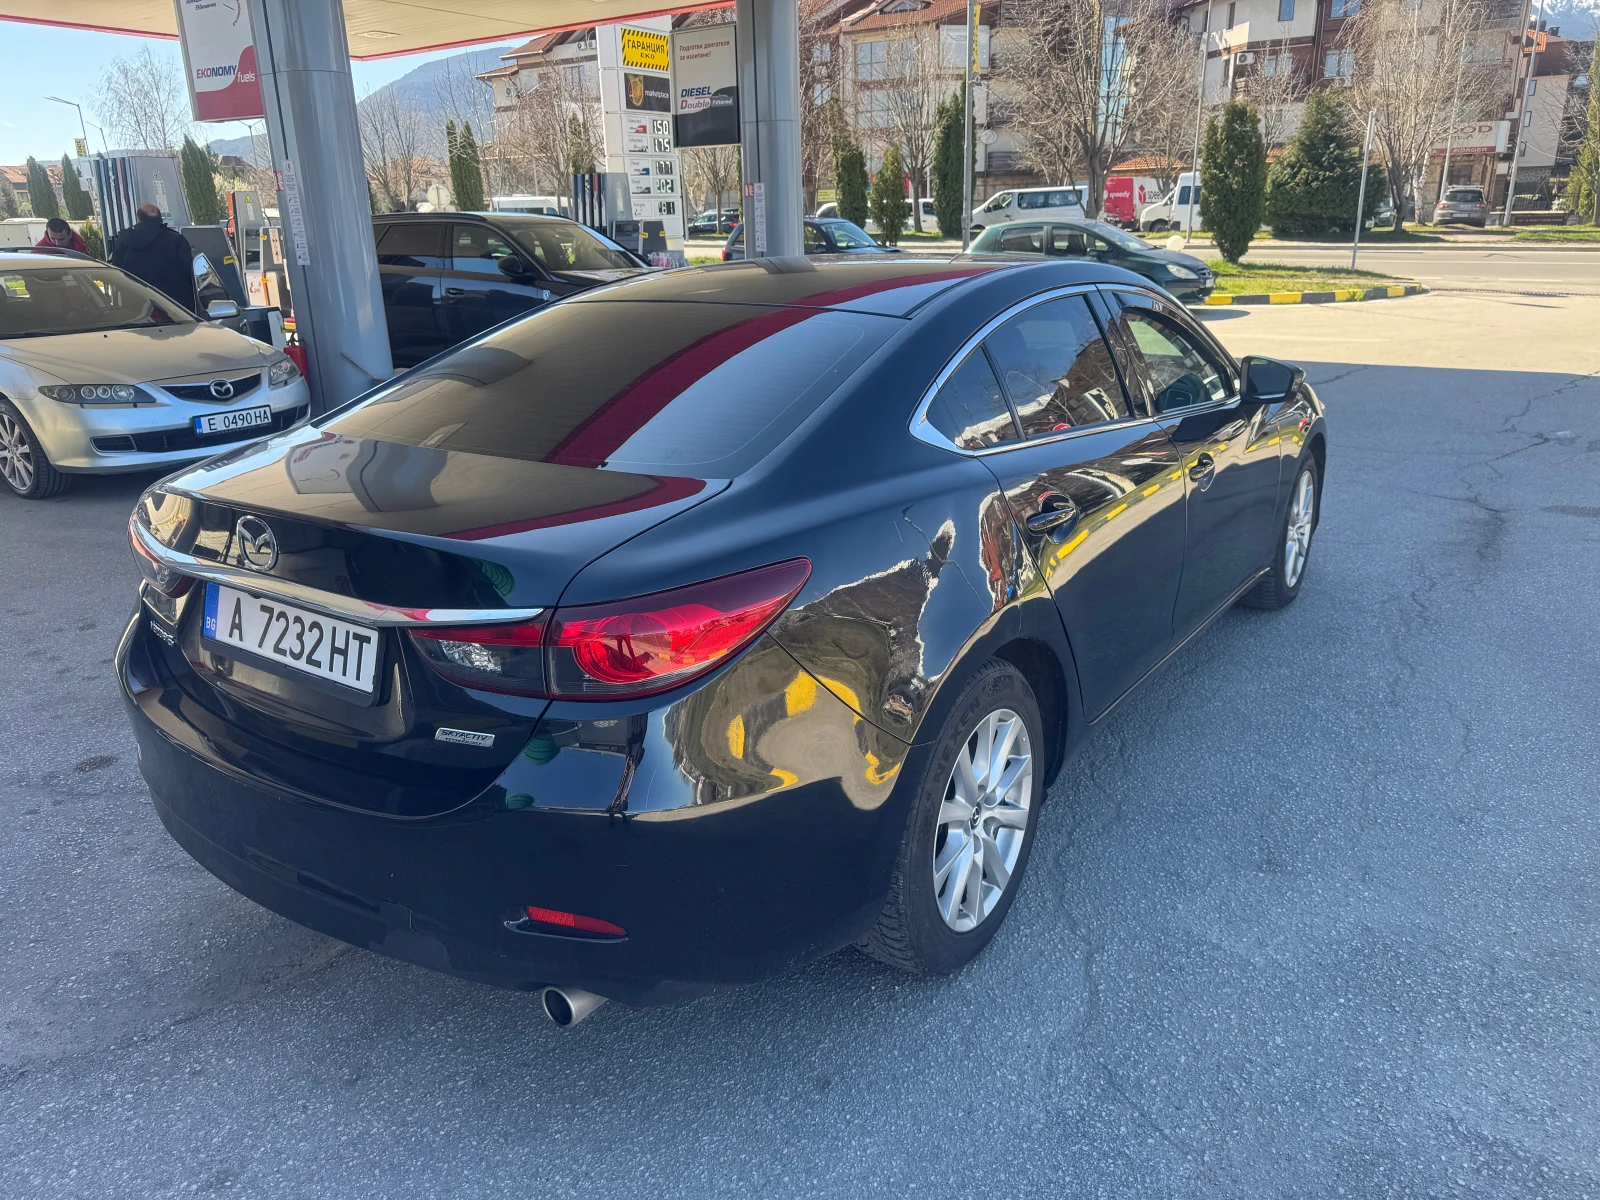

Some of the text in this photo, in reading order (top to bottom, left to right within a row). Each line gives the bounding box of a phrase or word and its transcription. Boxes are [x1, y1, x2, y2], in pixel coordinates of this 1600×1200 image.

[627, 39, 665, 54] ГАРАНЦИЯ
[679, 40, 730, 52] Подготви двигателя
[196, 65, 237, 79] EKONOMY
[237, 71, 255, 82] fuels
[644, 90, 670, 99] marketplace
[681, 86, 712, 98] DIESEL
[680, 98, 733, 110] Double Filtered
[1109, 190, 1130, 200] speedy
[207, 417, 217, 431] E
[205, 616, 216, 630] BG
[228, 597, 243, 642] A
[440, 730, 489, 740] SKYACTIV
[933, 696, 981, 783] NEXEN
